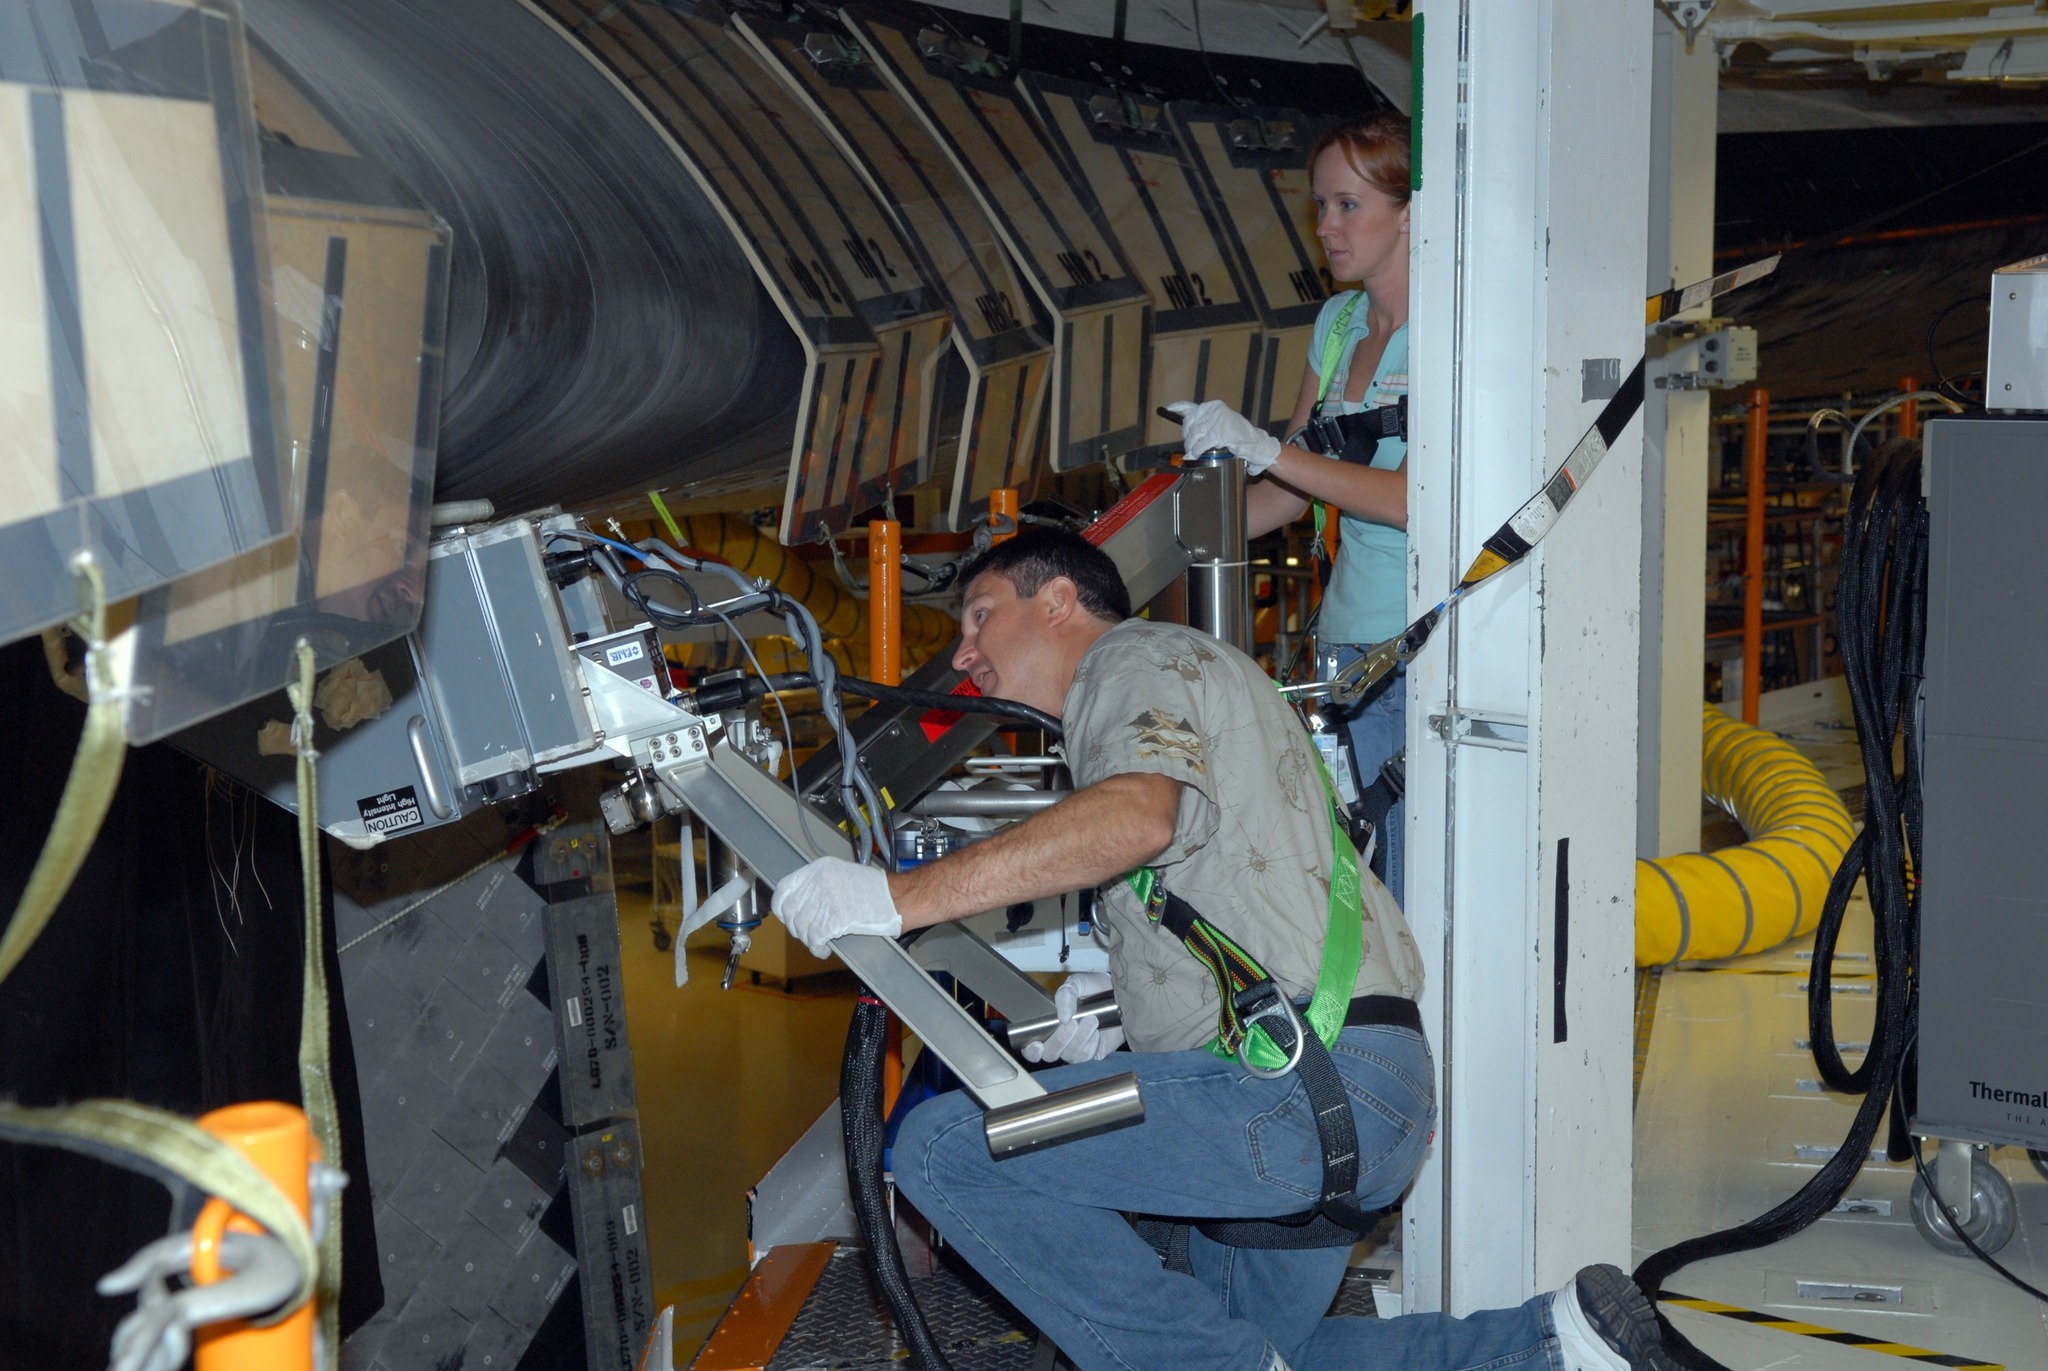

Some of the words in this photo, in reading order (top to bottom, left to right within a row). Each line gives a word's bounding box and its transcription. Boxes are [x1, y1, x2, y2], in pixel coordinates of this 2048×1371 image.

[1084, 250, 1110, 281] 2
[1191, 273, 1213, 305] 2
[999, 291, 1022, 327] 2
[363, 802, 396, 817] Intensity
[376, 793, 396, 805] Light
[397, 797, 416, 807] High
[368, 810, 418, 833] CAUTION
[1969, 1081, 2048, 1109] Thermal
[2006, 1113, 2032, 1125] THE
